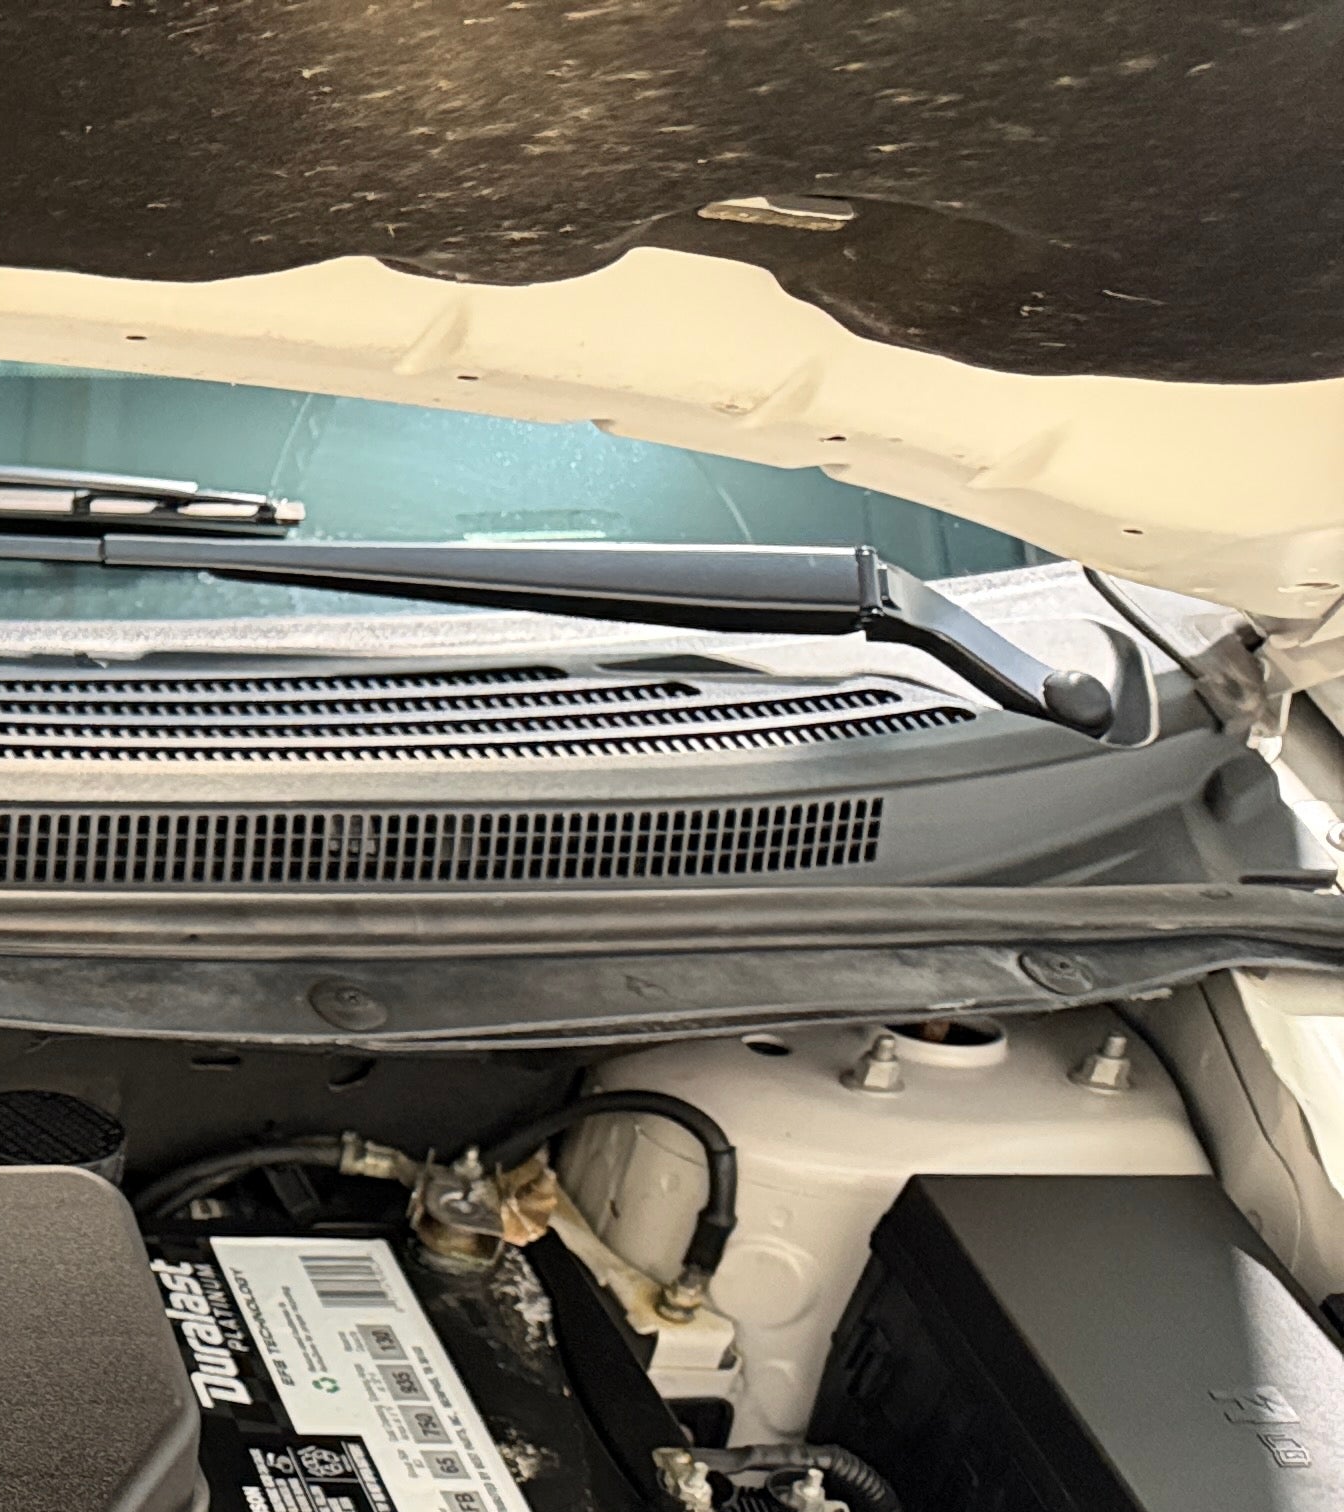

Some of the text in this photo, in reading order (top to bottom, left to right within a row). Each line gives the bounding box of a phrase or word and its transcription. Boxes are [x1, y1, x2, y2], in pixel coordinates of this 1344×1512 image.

[146, 1258, 255, 1408] Duralast
[192, 1263, 251, 1352] PLATINUM
[228, 1267, 295, 1385] EFB TECHNOLOGY
[370, 1330, 397, 1351] 130
[413, 1413, 442, 1436] 750
[434, 1457, 460, 1472] 65
